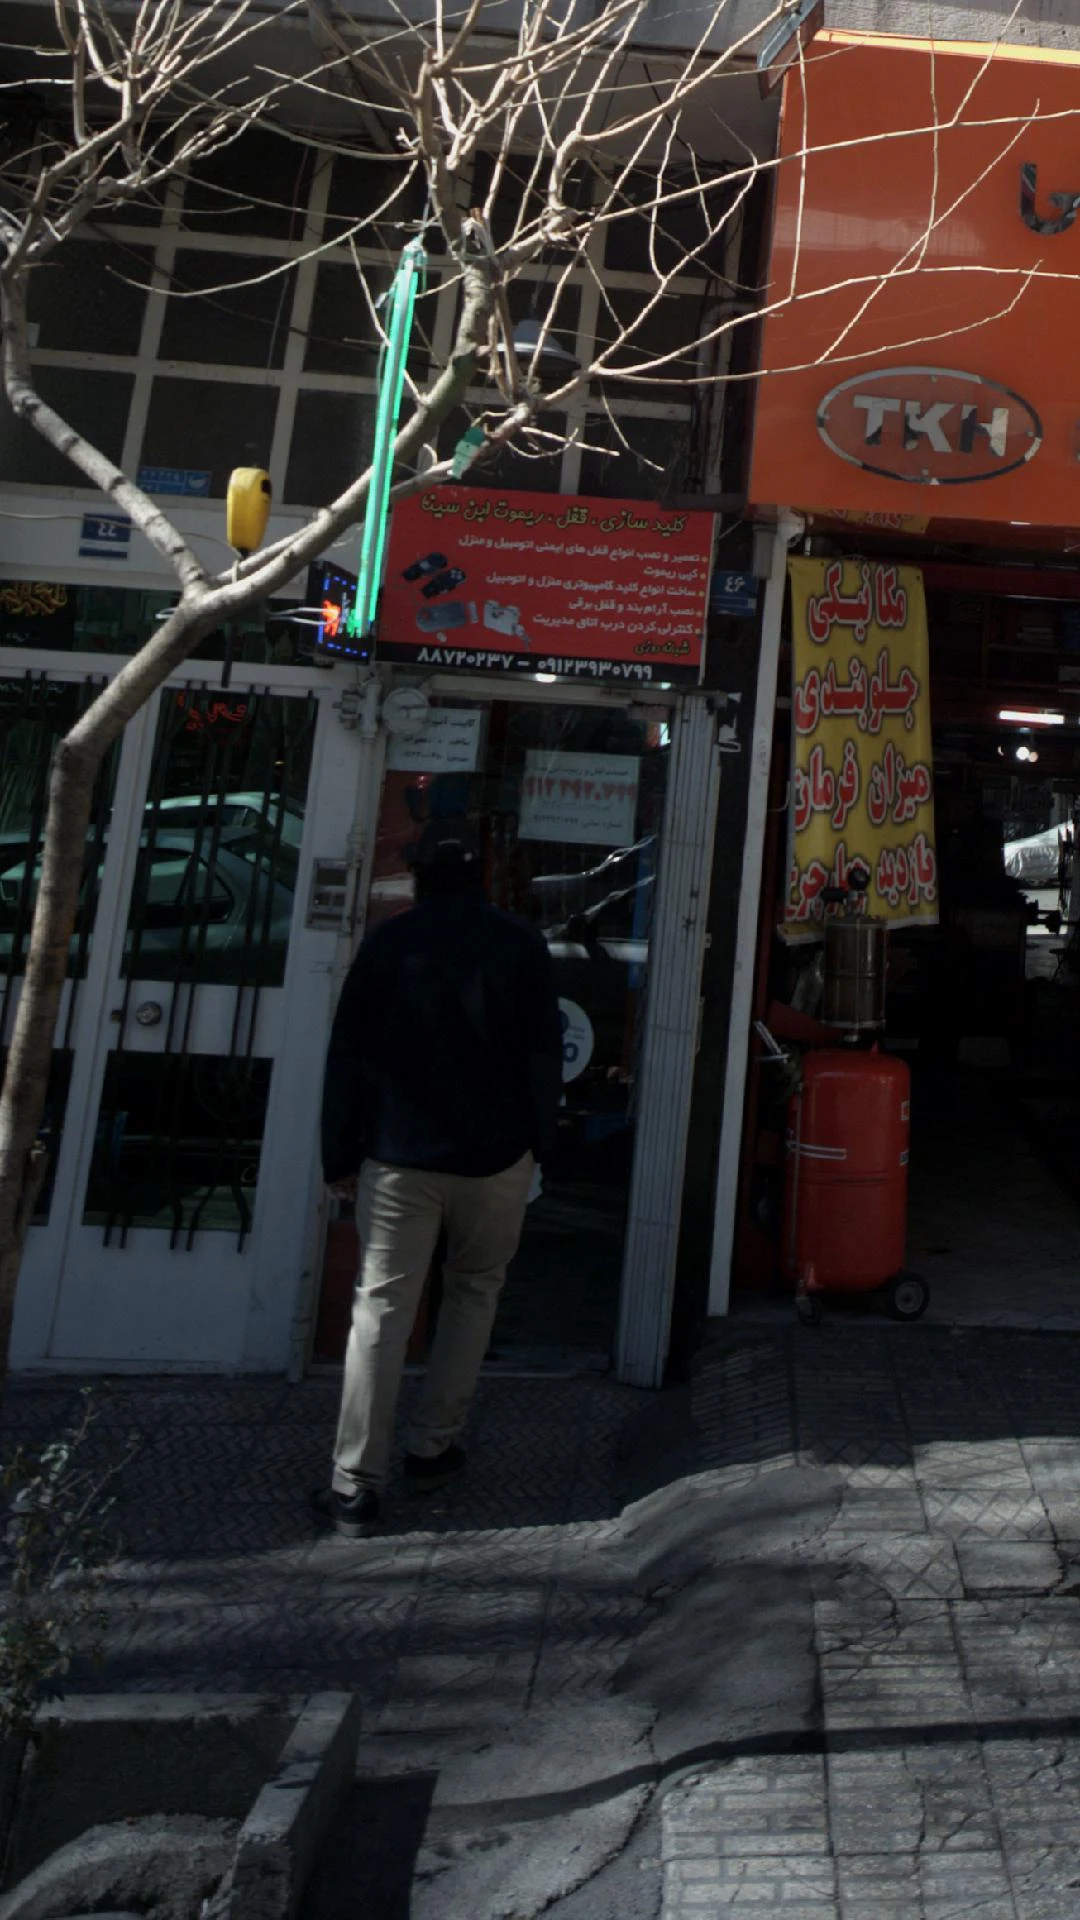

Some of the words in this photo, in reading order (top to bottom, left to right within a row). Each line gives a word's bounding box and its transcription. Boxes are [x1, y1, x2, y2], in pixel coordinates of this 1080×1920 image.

[853, 394, 1010, 458] TKH
[420, 493, 461, 519] سینا
[463, 498, 491, 523] ابن
[493, 499, 545, 527] ریموت
[556, 506, 589, 530] قفل
[600, 509, 649, 533] سازی
[651, 513, 690, 538] کلید
[458, 534, 486, 547] منزل
[609, 547, 635, 562] انواع
[643, 565, 677, 580] ریموت
[677, 568, 699, 581] کپی
[616, 582, 639, 595] کلید
[639, 584, 665, 599] انواع
[666, 585, 697, 597] ساخت
[568, 597, 593, 610] برقی
[594, 599, 616, 612] قفل
[670, 607, 695, 617] نصب
[532, 614, 575, 628] مدیریت
[576, 616, 599, 629] اتاق
[600, 620, 625, 632] درب
[627, 620, 657, 634] کردن
[657, 623, 695, 637] کنترلی
[793, 649, 919, 734] جلوبندی
[794, 740, 860, 832] فرمان
[868, 741, 932, 825] میزان
[877, 833, 937, 906] بازدید
